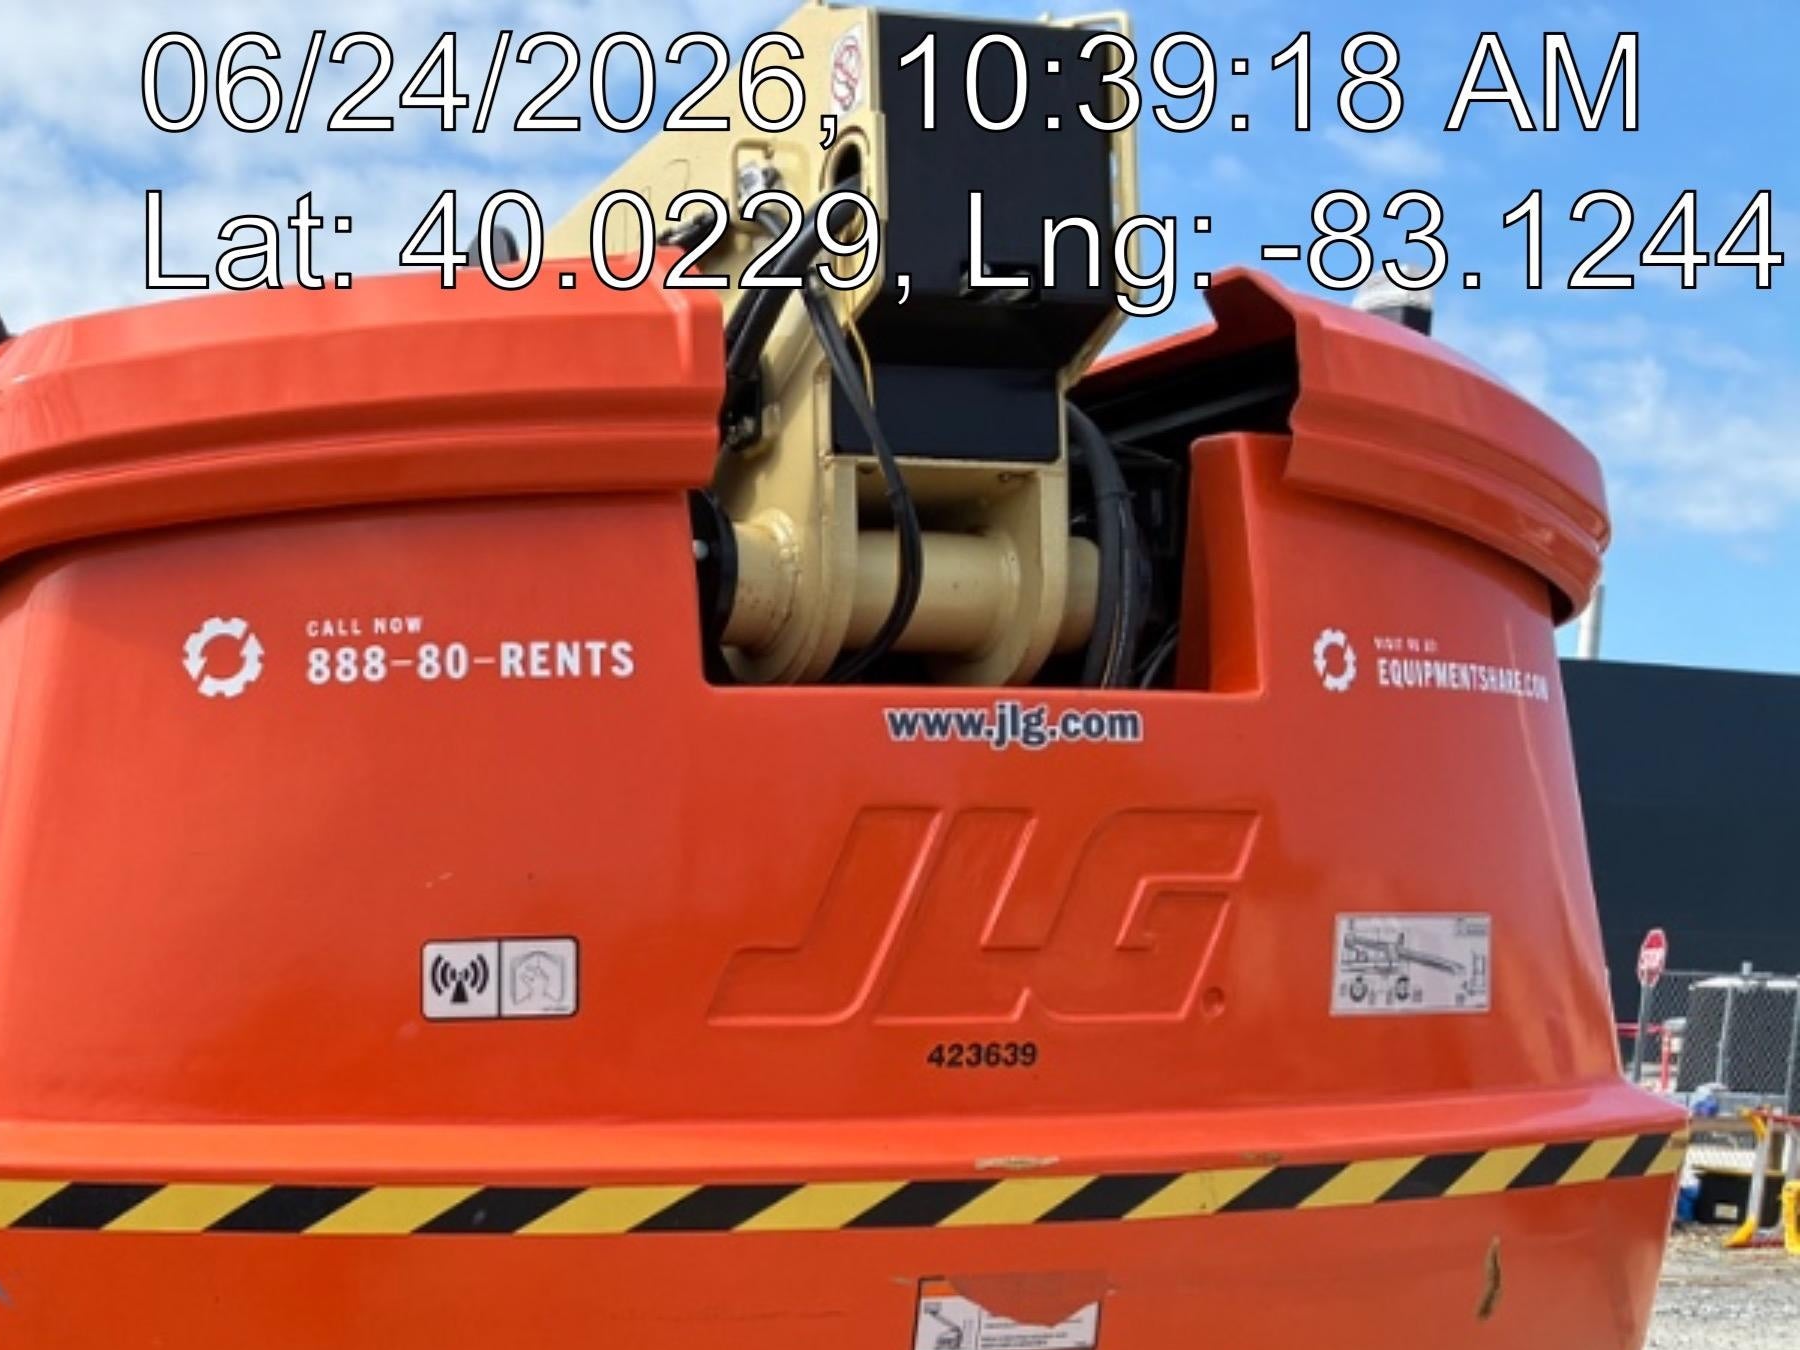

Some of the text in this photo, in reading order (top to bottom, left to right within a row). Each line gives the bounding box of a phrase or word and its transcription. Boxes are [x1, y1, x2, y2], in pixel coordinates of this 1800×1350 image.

[306, 616, 423, 637] CALL NOW
[307, 641, 635, 685] 888-80-RENTS
[884, 701, 1144, 750] www.jlg.com
[706, 806, 1262, 1027] JLG
[927, 1042, 1039, 1067] 423639
